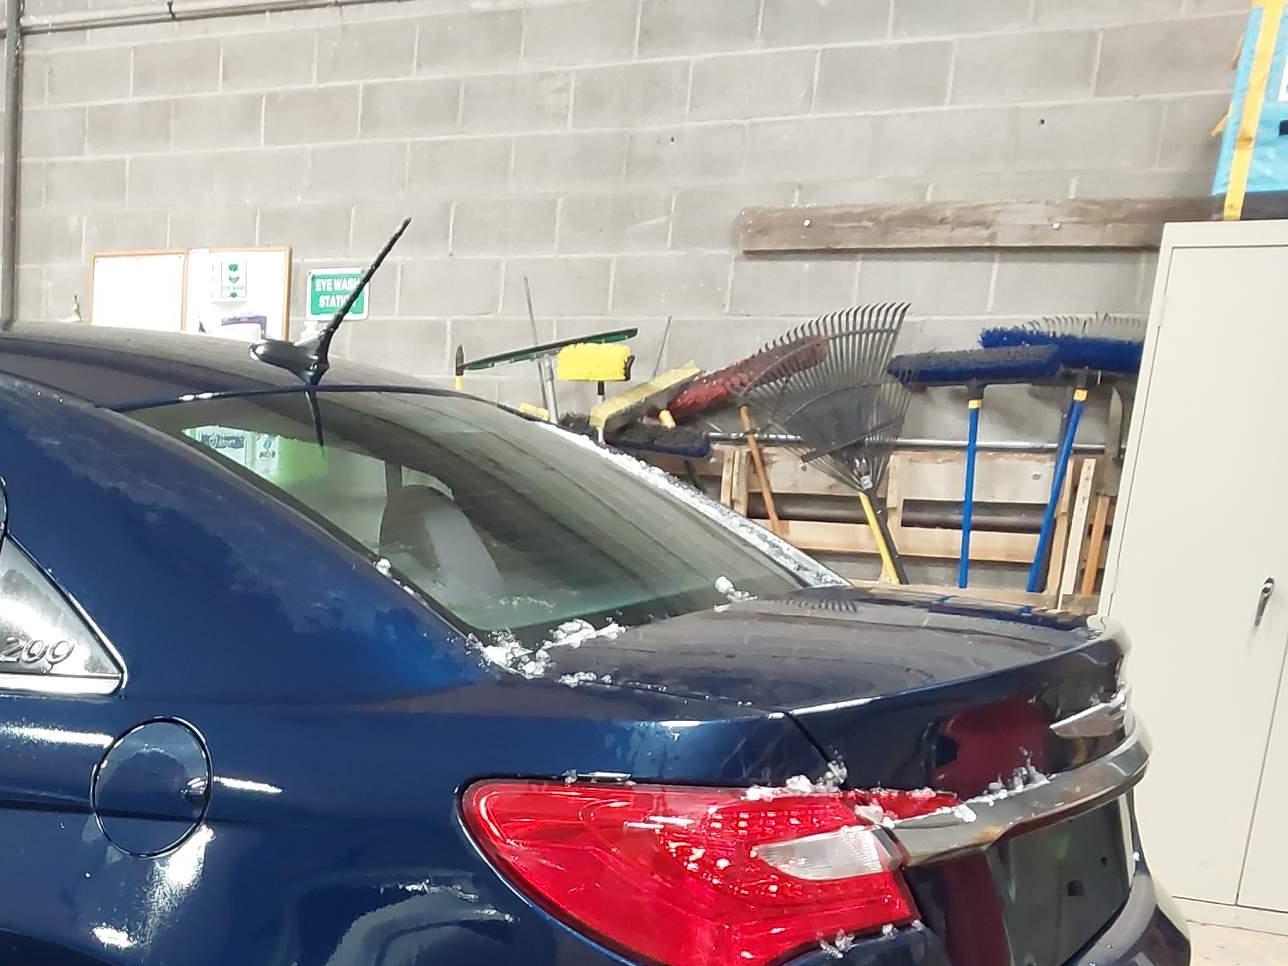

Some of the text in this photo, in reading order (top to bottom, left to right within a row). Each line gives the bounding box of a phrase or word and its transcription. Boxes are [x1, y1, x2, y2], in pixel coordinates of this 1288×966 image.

[315, 278, 360, 291] EYE WASH
[318, 294, 357, 308] STATI
